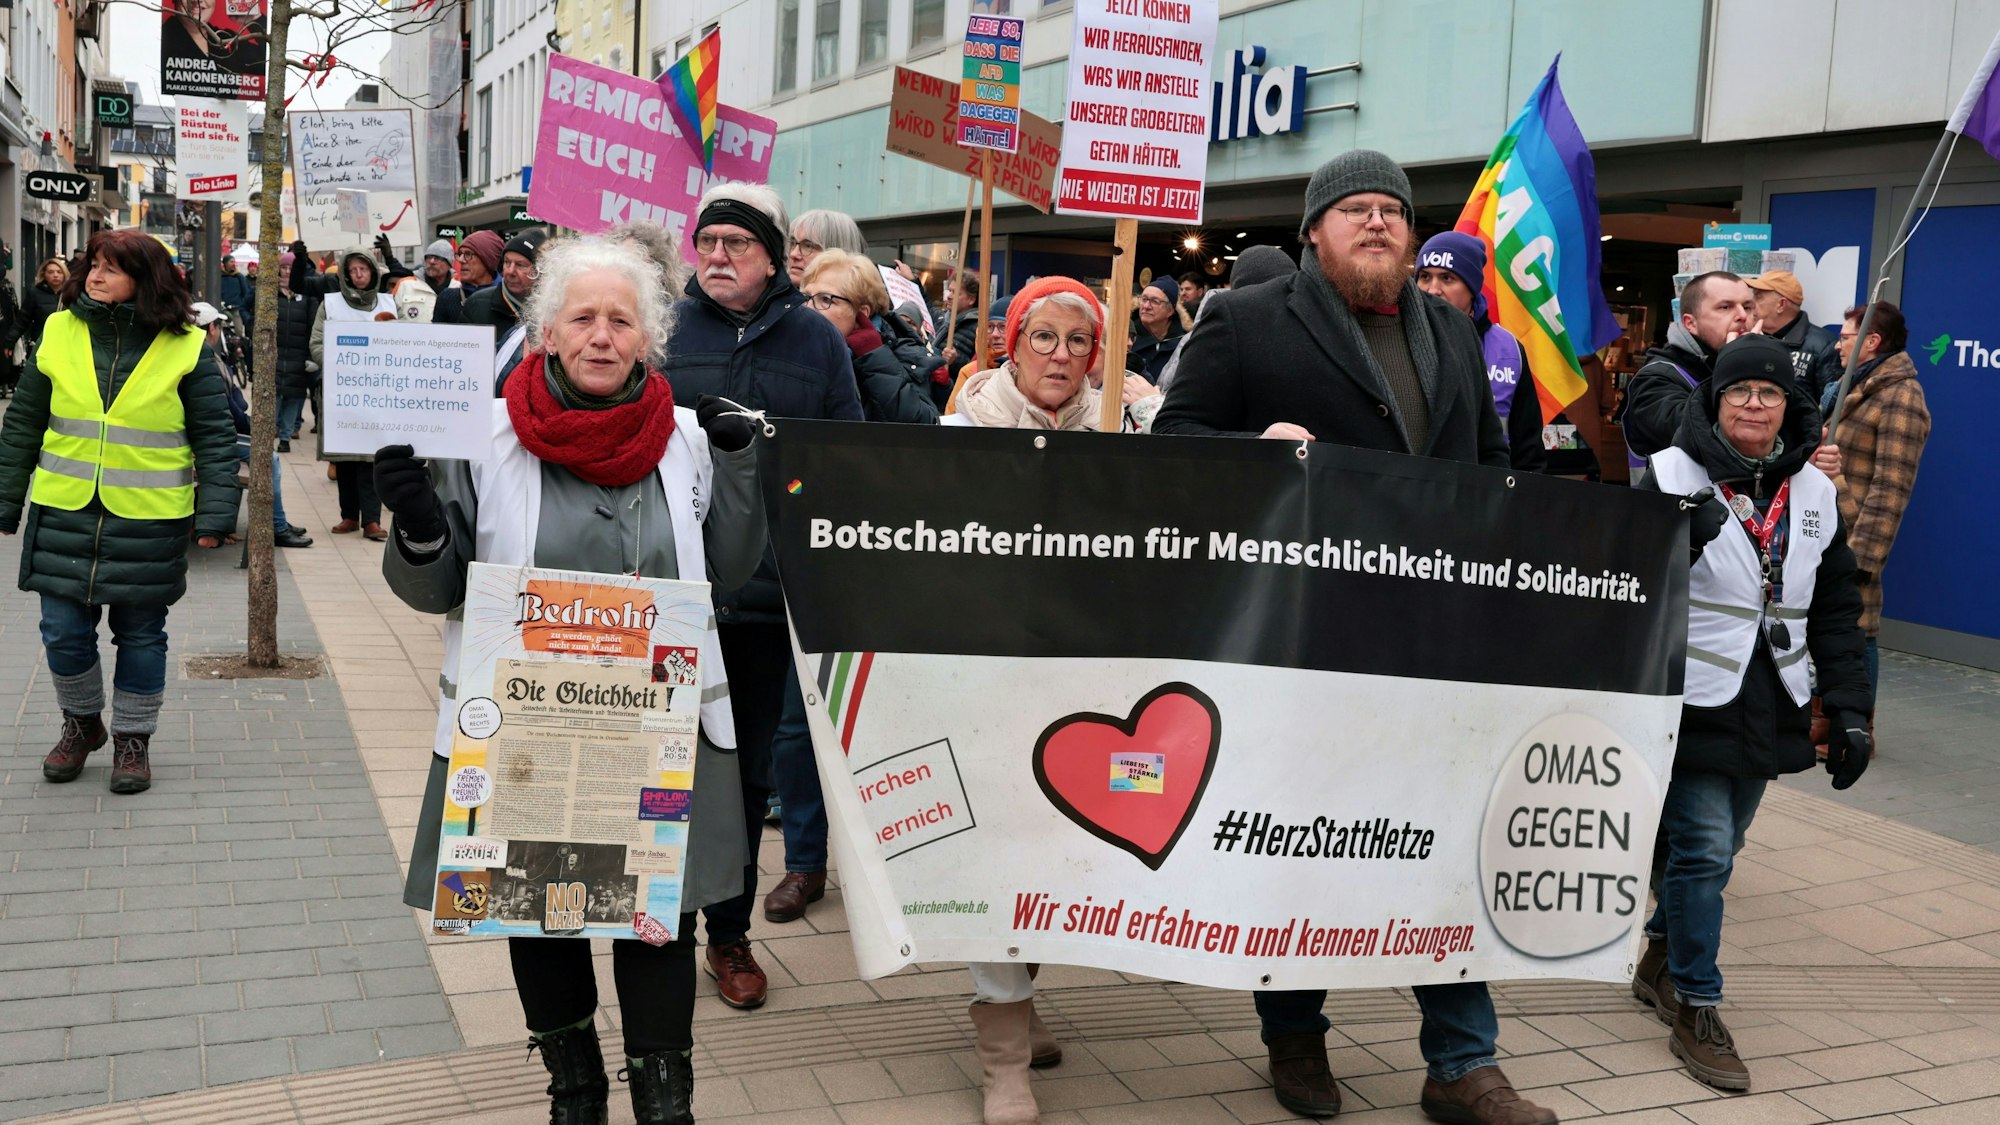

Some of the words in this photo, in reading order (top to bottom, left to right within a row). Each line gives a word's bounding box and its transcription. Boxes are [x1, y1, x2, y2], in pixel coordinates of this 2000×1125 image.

[1105, 0, 1138, 16] JETZT
[969, 18, 999, 36] LEBE
[1002, 21, 1020, 40] SO,
[964, 40, 996, 58] DASS
[1000, 45, 1019, 62] DIE
[1084, 27, 1109, 50] WIR
[1113, 31, 1203, 66] HERAUSFINDEN,
[165, 57, 217, 71] ANDREA
[979, 63, 1003, 81] AFD
[165, 70, 260, 87] KANONENBERG
[897, 67, 943, 98] WENN
[1083, 65, 1114, 88] WAS
[1117, 69, 1142, 90] WIR
[1144, 72, 1199, 98] ANSTELLE
[188, 85, 218, 94] SCANNEN,
[232, 88, 260, 96] WÄHLEN!
[976, 82, 1005, 101] WAS
[181, 108, 199, 117] Bei
[202, 109, 221, 119] der
[960, 102, 1018, 124] DAGEGEN
[1070, 101, 1127, 126] UNSERER
[181, 119, 228, 132] Rüstung
[332, 117, 354, 130] bring
[361, 117, 384, 127] bitte
[894, 110, 936, 139] WIRD
[181, 130, 205, 139] sind
[208, 132, 224, 140] sie
[226, 133, 240, 142] fix
[301, 133, 329, 151] Alice
[330, 134, 339, 145] &
[964, 125, 1010, 148] HÄTTE!
[303, 152, 334, 170] Feinde
[336, 154, 357, 166] der
[556, 126, 657, 183] EUCH
[1028, 135, 1060, 168] WIRD
[1090, 141, 1130, 164] GETAN
[1132, 141, 1181, 169] HÄTTEN.
[29, 177, 86, 195] ONLY
[193, 181, 211, 191] Die
[211, 177, 235, 189] Linke
[1060, 178, 1085, 201] NIE
[1087, 180, 1137, 205] WIEDER
[1139, 185, 1161, 207] IST
[1161, 188, 1200, 212] JETZT!
[1423, 251, 1454, 269] Volt
[372, 337, 411, 346] Mitarbeiter
[427, 339, 480, 350] Abgeordneten
[336, 352, 361, 366] AfD
[364, 352, 380, 367] im
[385, 354, 462, 374] Bundestag
[336, 372, 410, 392] beschäftigt
[414, 377, 454, 390] mehr
[458, 377, 479, 392] als
[1487, 365, 1516, 384] Volt
[336, 394, 359, 407] 100
[363, 394, 470, 412] Rechtsextreme
[337, 420, 360, 430] Stand:
[361, 422, 401, 432] 12.03.2024
[403, 423, 429, 433] 05:00
[430, 424, 448, 434] Uhr
[1804, 510, 1820, 519] OM
[809, 517, 1135, 559] Botschafterinnen
[1144, 526, 1200, 560] für
[1208, 531, 1455, 582] Menschlichkeit
[1460, 558, 1512, 588] und
[1515, 562, 1648, 604] Solidarität.
[548, 642, 570, 650] nicht
[571, 643, 589, 651] zum
[591, 644, 622, 653] Mandat
[550, 632, 562, 640] zu
[562, 632, 594, 642] werden,
[595, 634, 622, 644] gehört
[506, 677, 546, 702] Die
[556, 680, 657, 710] Gleichheit
[463, 767, 477, 775] AUS
[1120, 759, 1138, 768] LIEBE
[1523, 742, 1622, 787] OMAS
[1127, 773, 1141, 781] ALS
[1128, 767, 1159, 780] STÄRKER
[859, 764, 932, 804] irchen
[1213, 810, 1435, 861] #HerzStattHetze
[1507, 806, 1631, 852] GEGEN
[452, 848, 499, 860] FRAUEN
[546, 881, 587, 913] NO
[1493, 869, 1639, 917] RECHTS
[545, 911, 585, 931] NAZIS
[1013, 892, 1060, 932] Wir
[1063, 895, 1125, 937] sind
[1131, 904, 1239, 954] erfahren
[1244, 919, 1294, 957] und
[1296, 918, 1378, 957] kennen
[1381, 918, 1475, 963] Lösungen.
